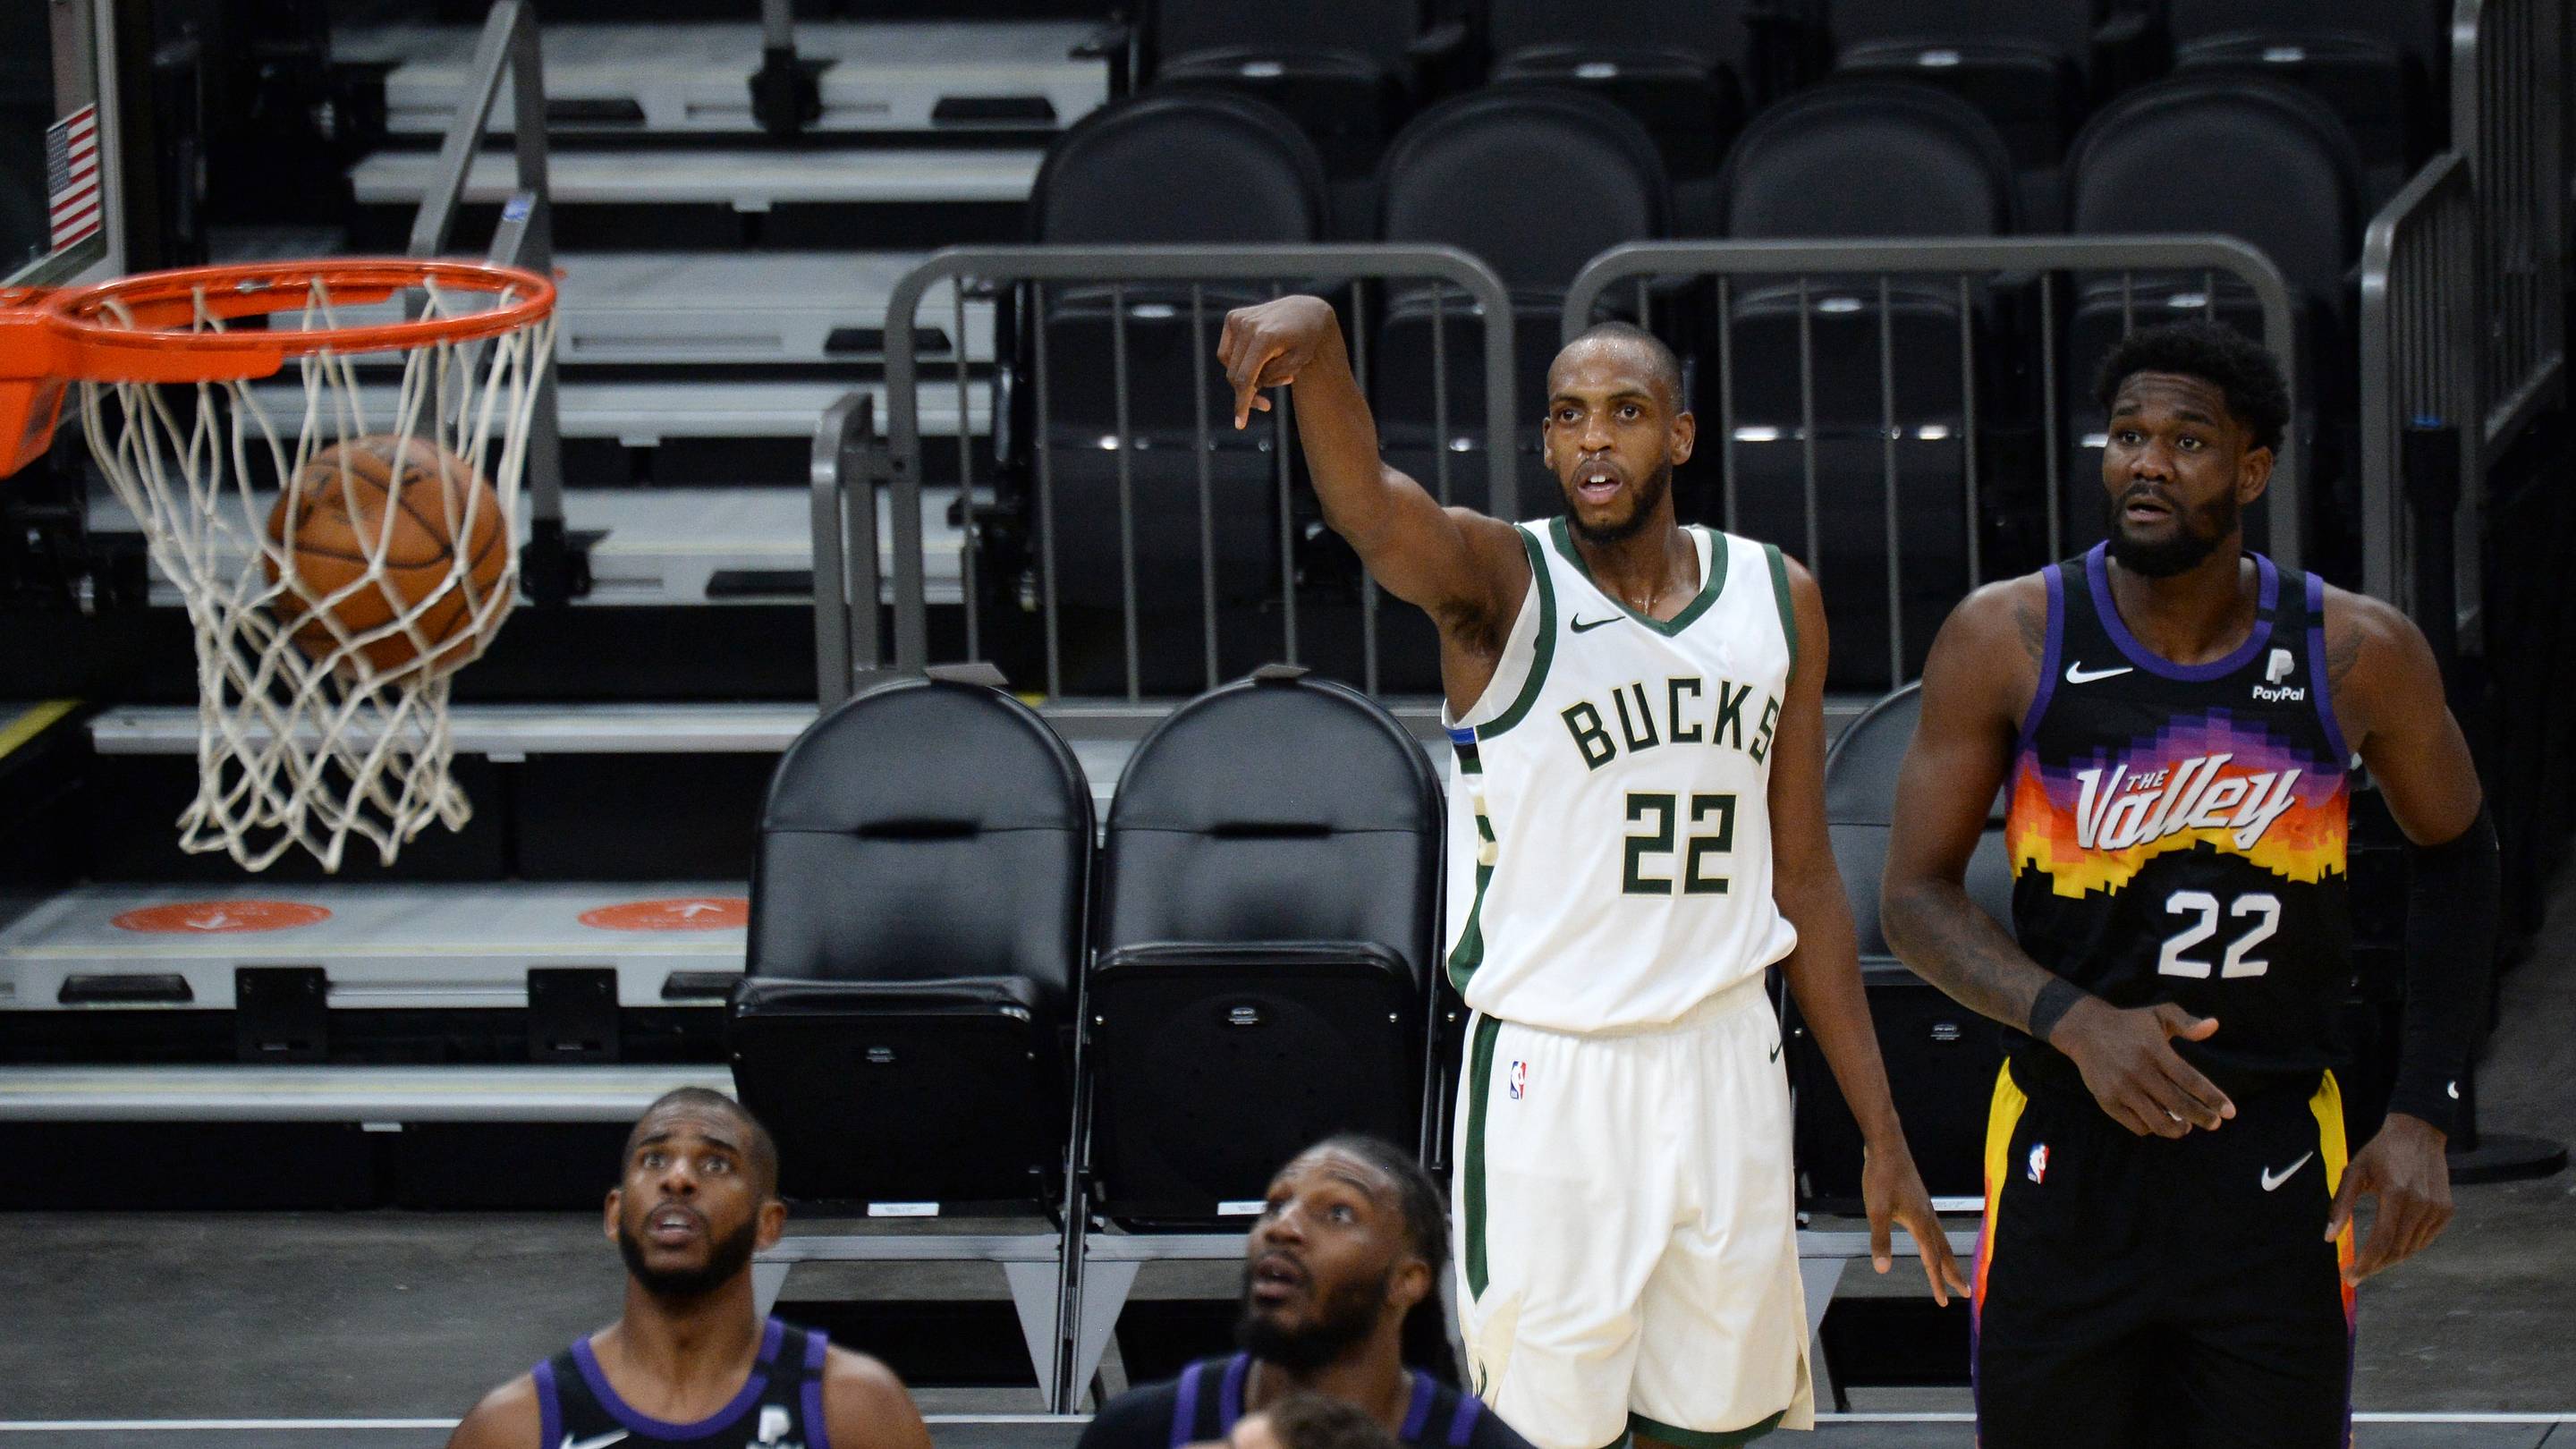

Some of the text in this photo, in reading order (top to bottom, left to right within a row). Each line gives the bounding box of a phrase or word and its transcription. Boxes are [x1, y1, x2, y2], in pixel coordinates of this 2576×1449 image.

[1561, 676, 1780, 773] BUCKS
[2252, 685, 2305, 702] PayPal
[2076, 753, 2303, 851] Valley
[2125, 768, 2170, 793] THE
[1623, 792, 1736, 895] 22
[2157, 891, 2282, 979] 22
